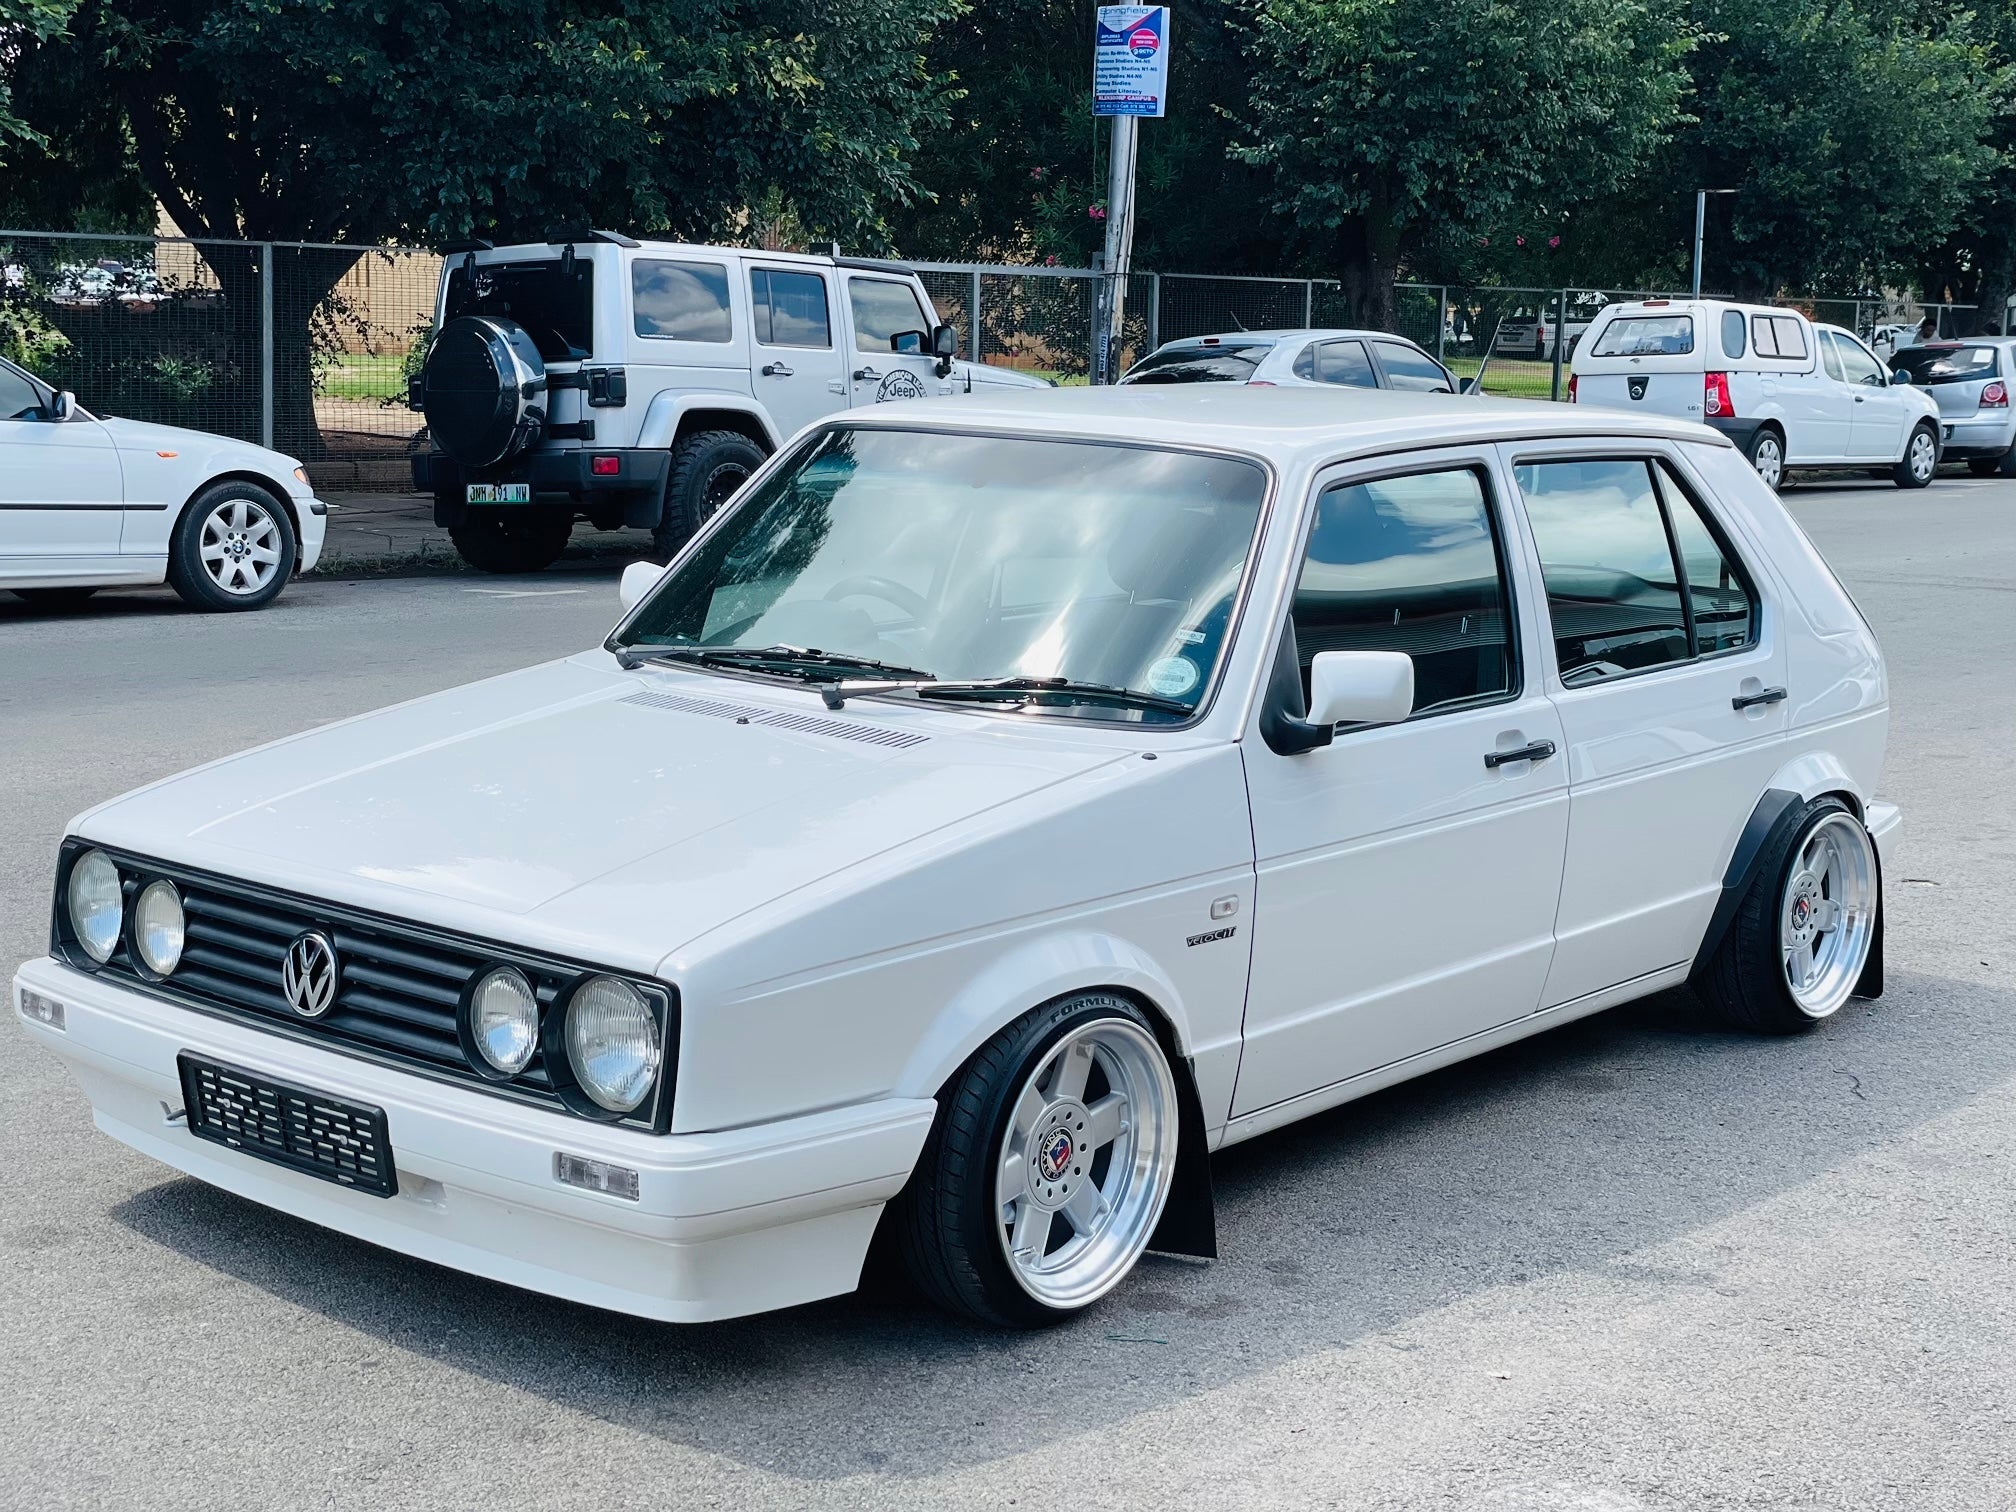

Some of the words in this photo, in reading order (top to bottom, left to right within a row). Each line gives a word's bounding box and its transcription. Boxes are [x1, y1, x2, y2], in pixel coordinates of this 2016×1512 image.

[890, 383, 916, 399] Jeep
[492, 486, 508, 501] 191
[1049, 996, 1133, 1024] FORMULA
